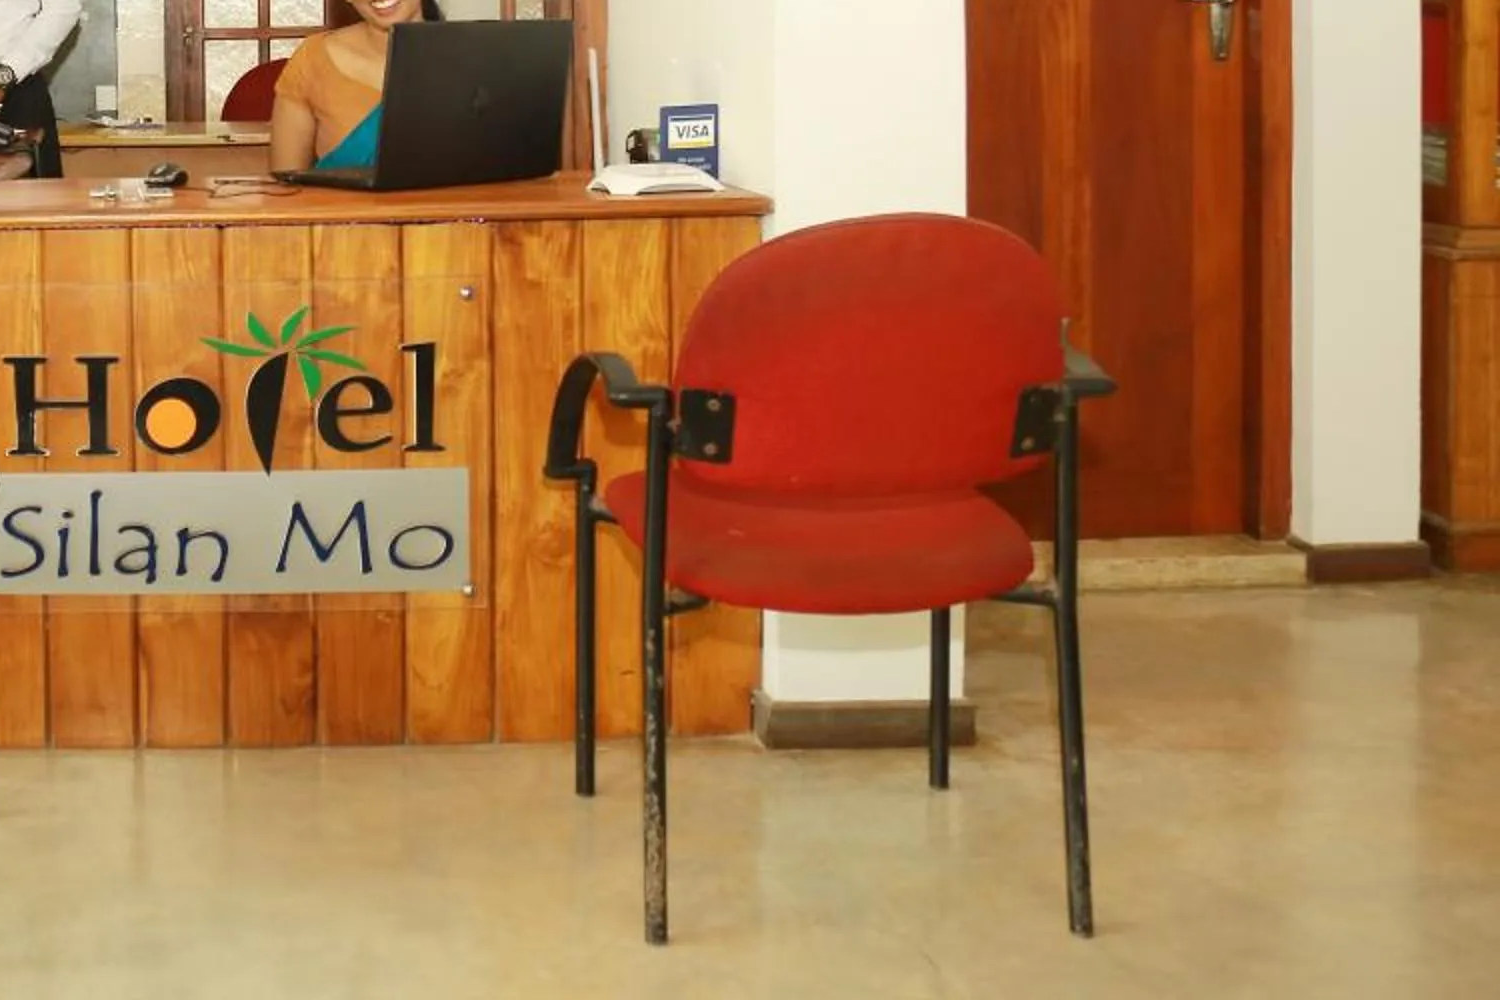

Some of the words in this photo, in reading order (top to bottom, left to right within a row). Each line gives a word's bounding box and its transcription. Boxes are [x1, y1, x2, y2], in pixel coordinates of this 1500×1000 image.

[675, 125, 709, 140] VISA
[2, 306, 446, 477] Hotel
[0, 490, 230, 585] Silan
[274, 500, 455, 575] Mo
